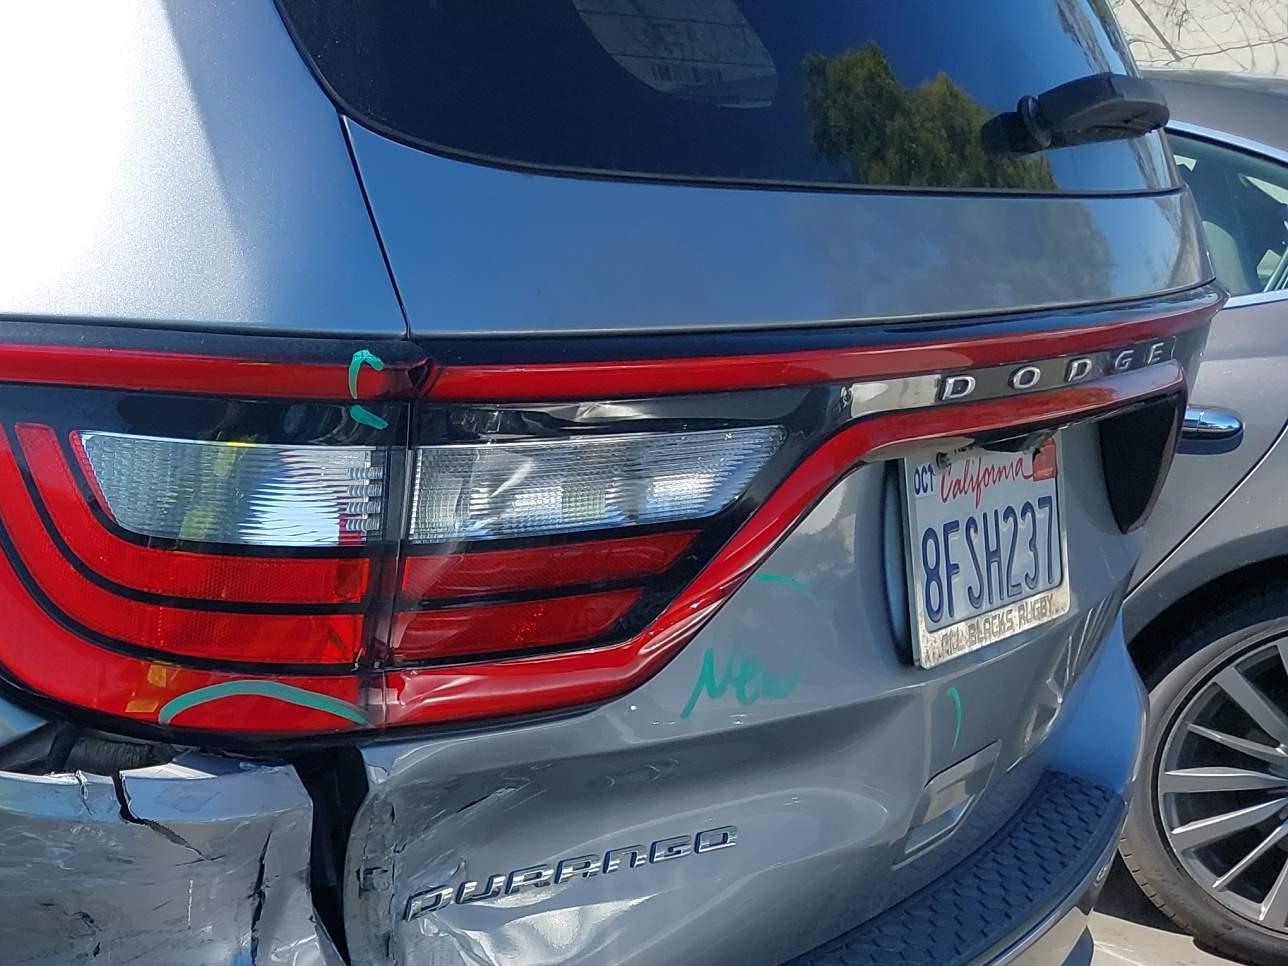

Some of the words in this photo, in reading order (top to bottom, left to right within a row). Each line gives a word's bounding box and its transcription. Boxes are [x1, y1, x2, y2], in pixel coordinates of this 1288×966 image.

[941, 342, 1164, 401] DODGE
[914, 464, 936, 495] OCT
[940, 456, 1034, 509] California
[921, 495, 1054, 624] 8FSH237
[967, 609, 1014, 646] BLACKS
[1017, 594, 1055, 628] RUGBY
[680, 646, 803, 720] New
[403, 826, 738, 922] DURANGO
